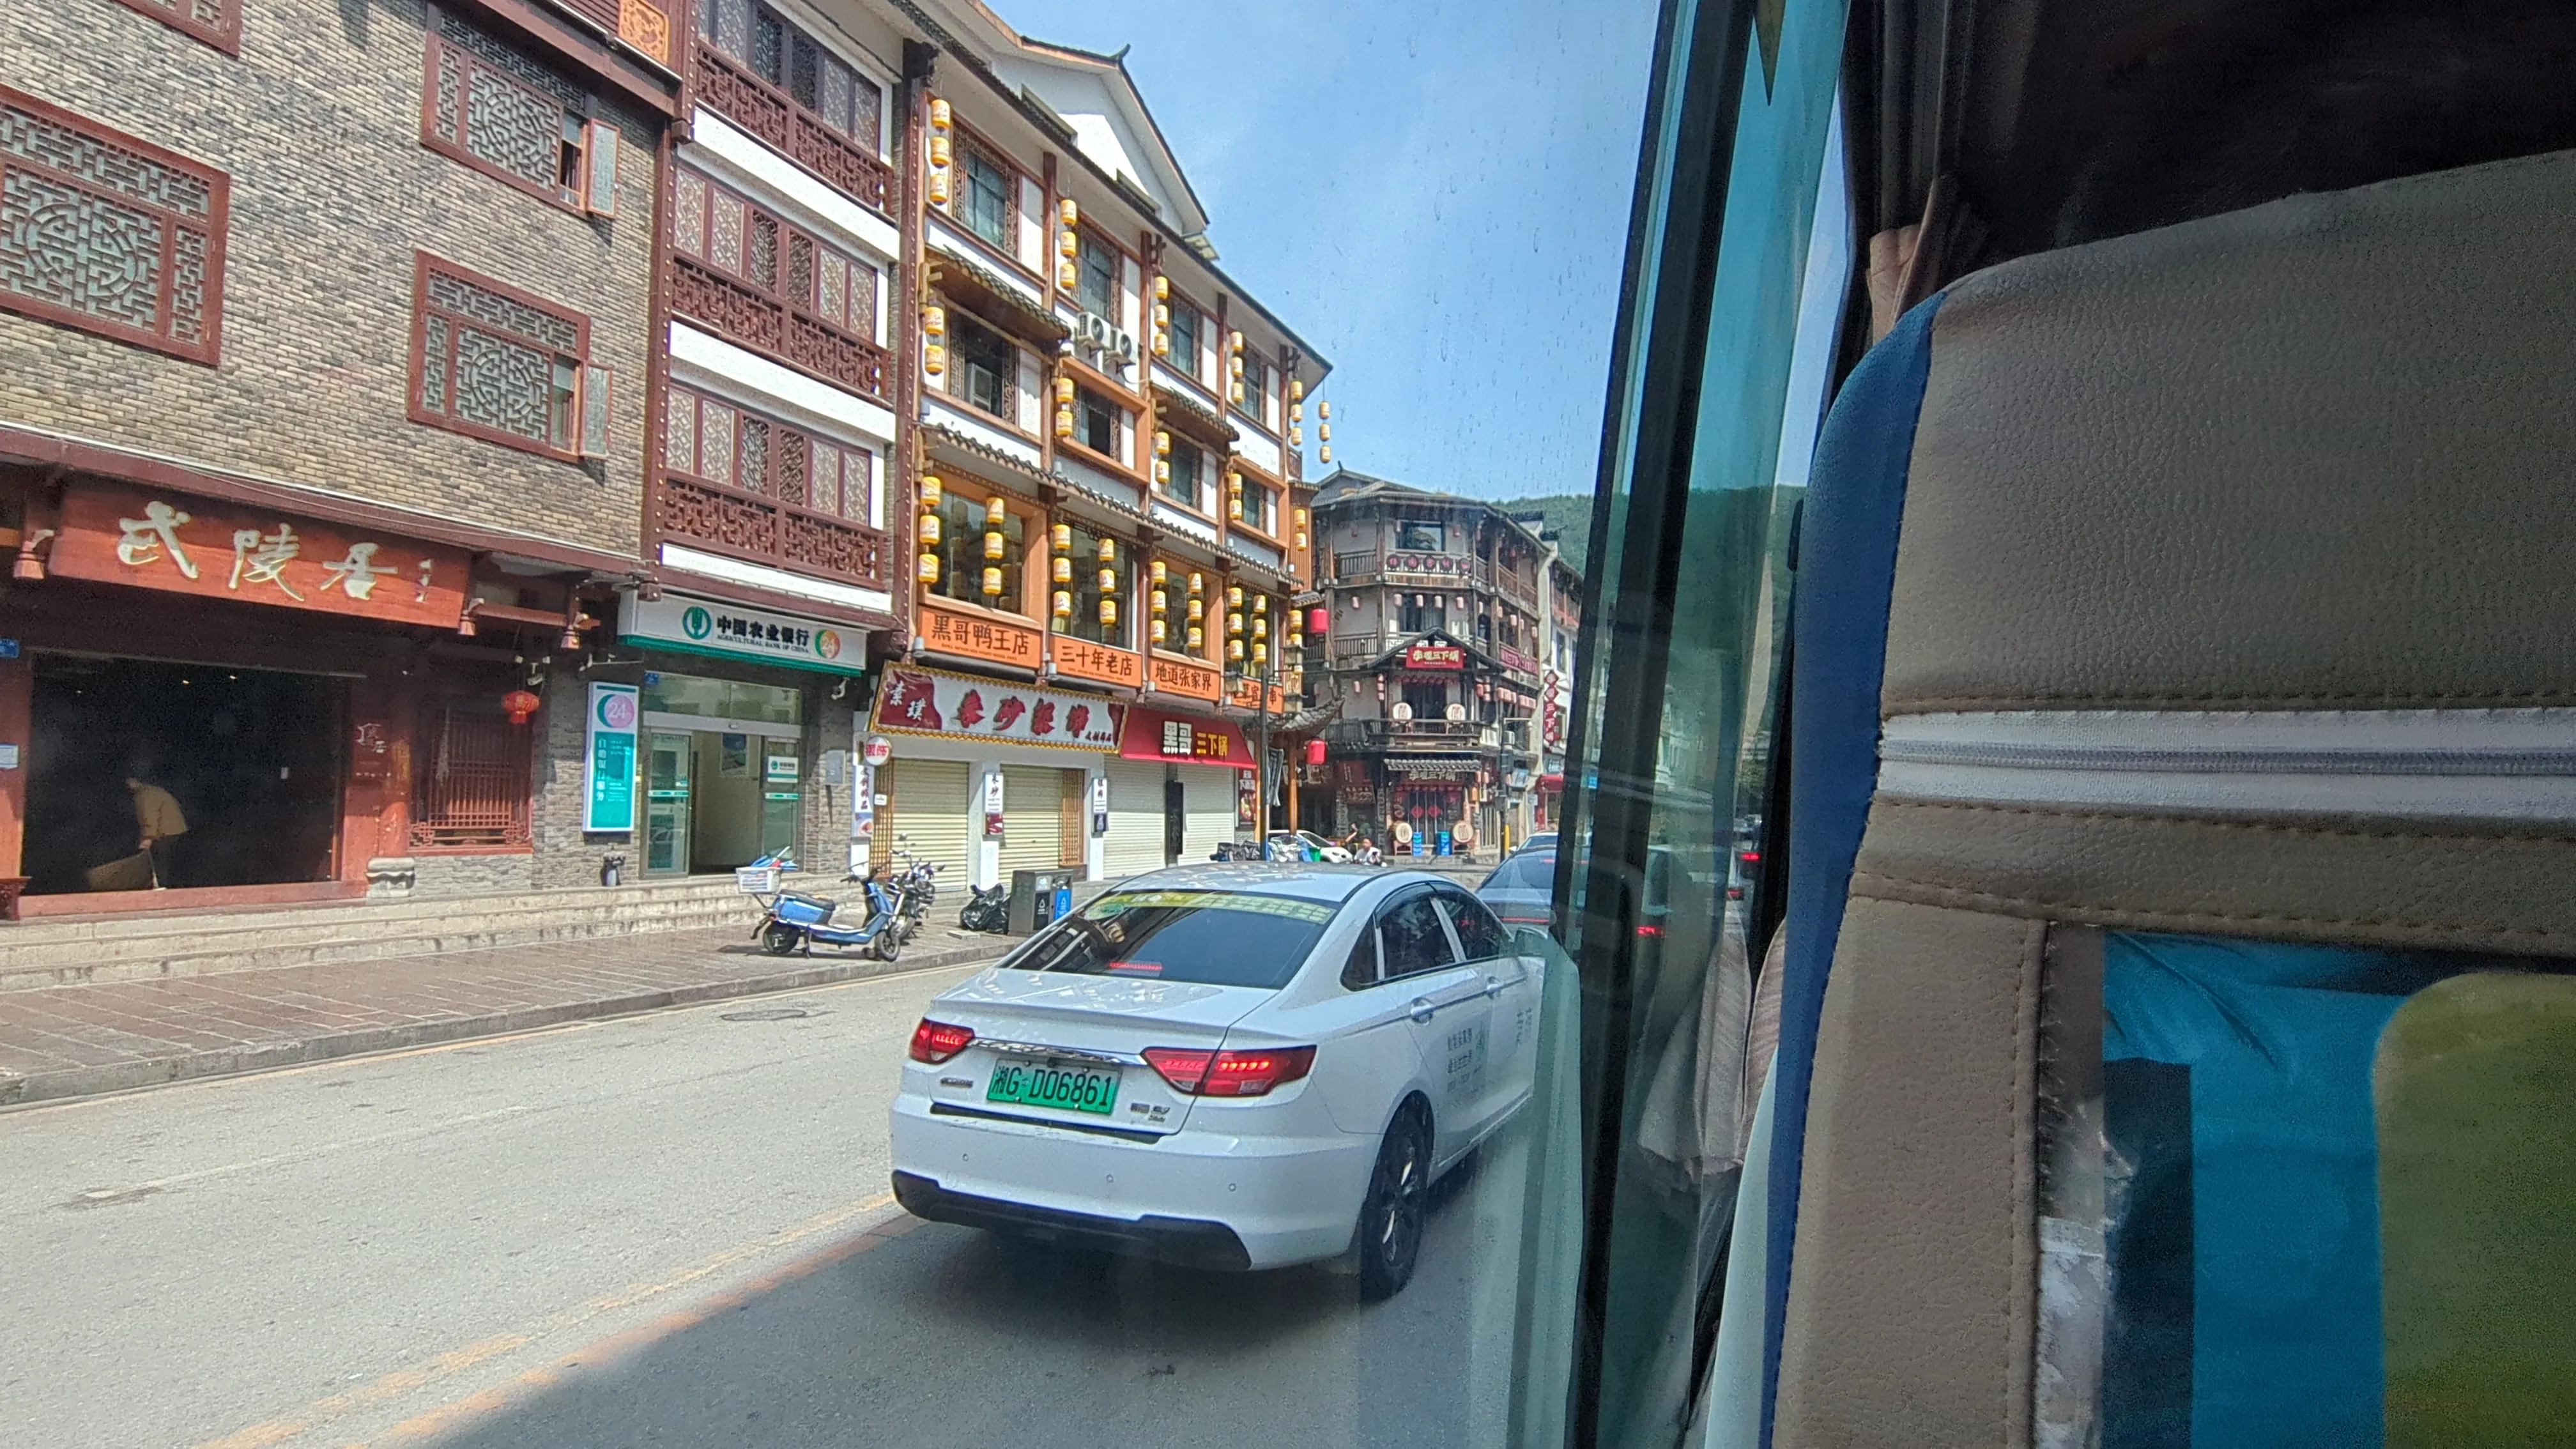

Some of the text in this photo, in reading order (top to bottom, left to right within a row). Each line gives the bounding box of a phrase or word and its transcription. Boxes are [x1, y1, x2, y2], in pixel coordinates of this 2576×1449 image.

[717, 615, 809, 646] 中国农业银行
[717, 634, 762, 646] AGRICULTURAL
[765, 641, 780, 649] BANK
[931, 614, 1029, 656] 黑哥鸭王店
[1060, 645, 1132, 677] 三十年老店
[1155, 663, 1211, 691] 地道张家界
[608, 702, 626, 719] 24
[1163, 721, 1228, 756] 黑哥 三下锅
